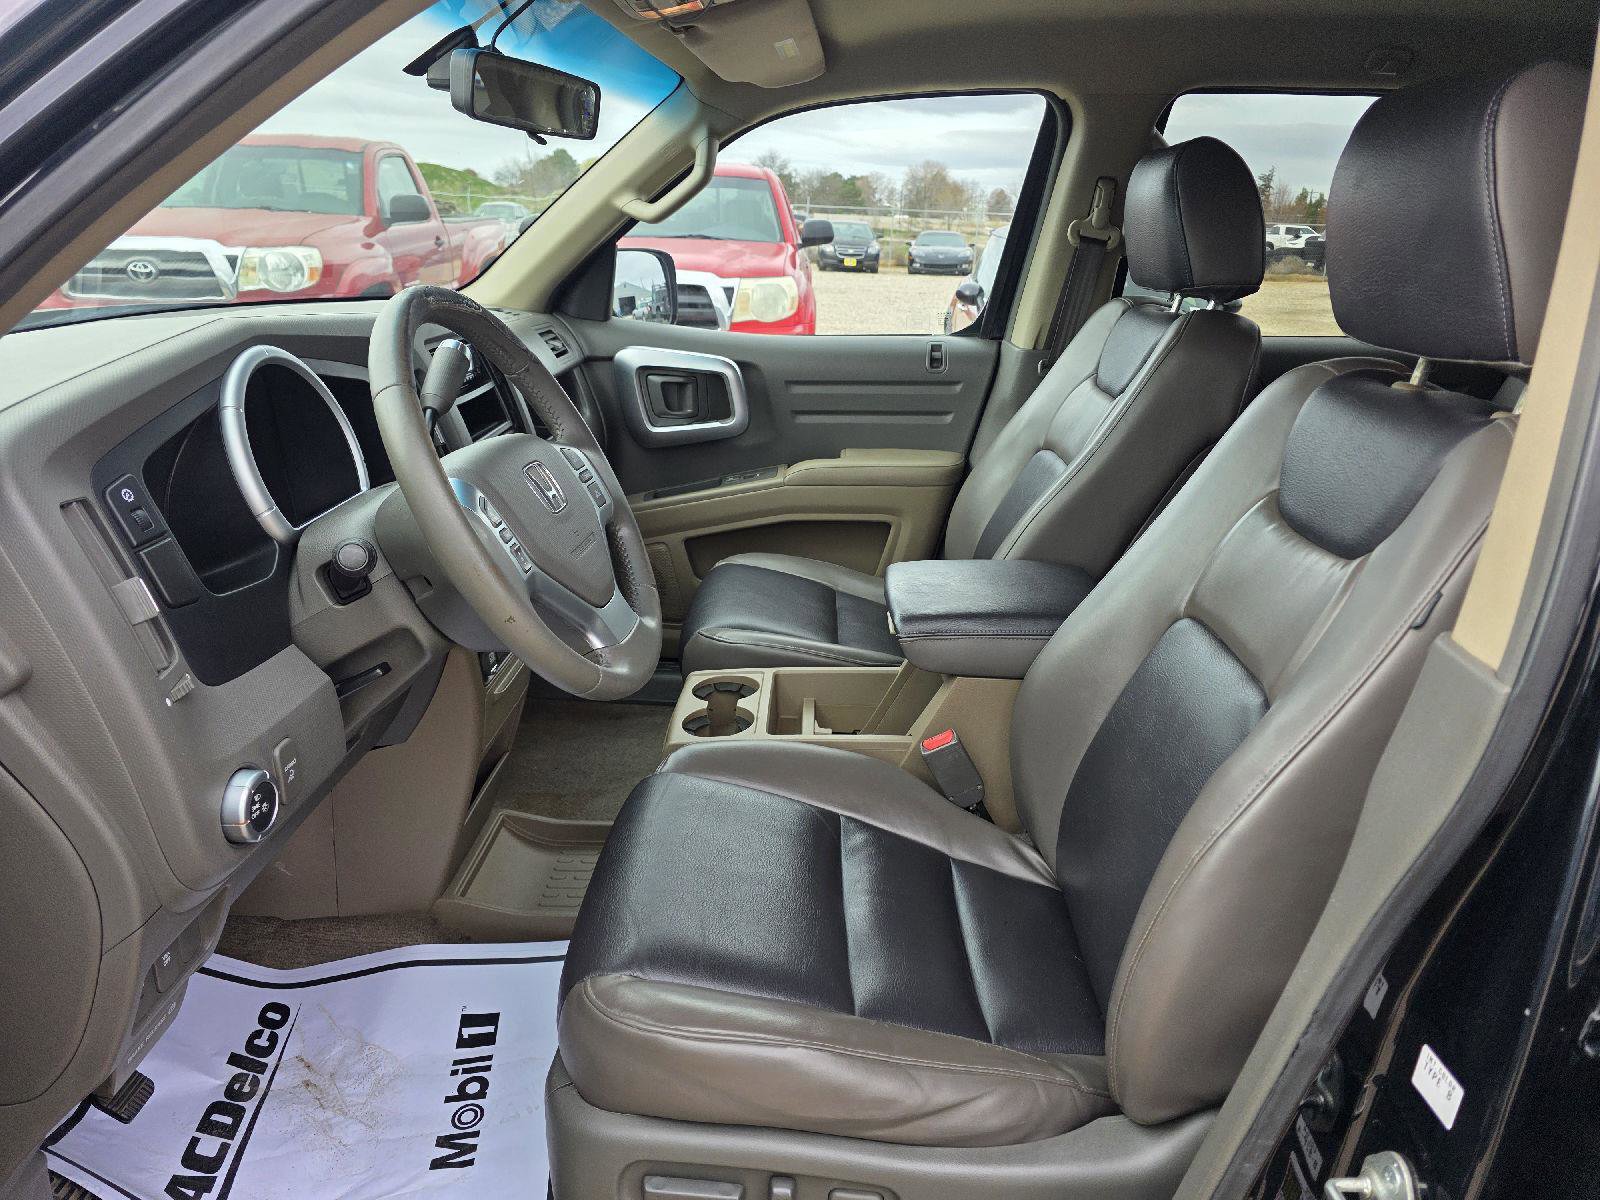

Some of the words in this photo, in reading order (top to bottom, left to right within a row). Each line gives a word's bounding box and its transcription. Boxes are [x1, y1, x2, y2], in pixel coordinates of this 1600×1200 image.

[163, 1001, 291, 1200] ACDelco
[429, 1054, 494, 1171] Mobil
[1423, 1060, 1442, 1088] TYPE
